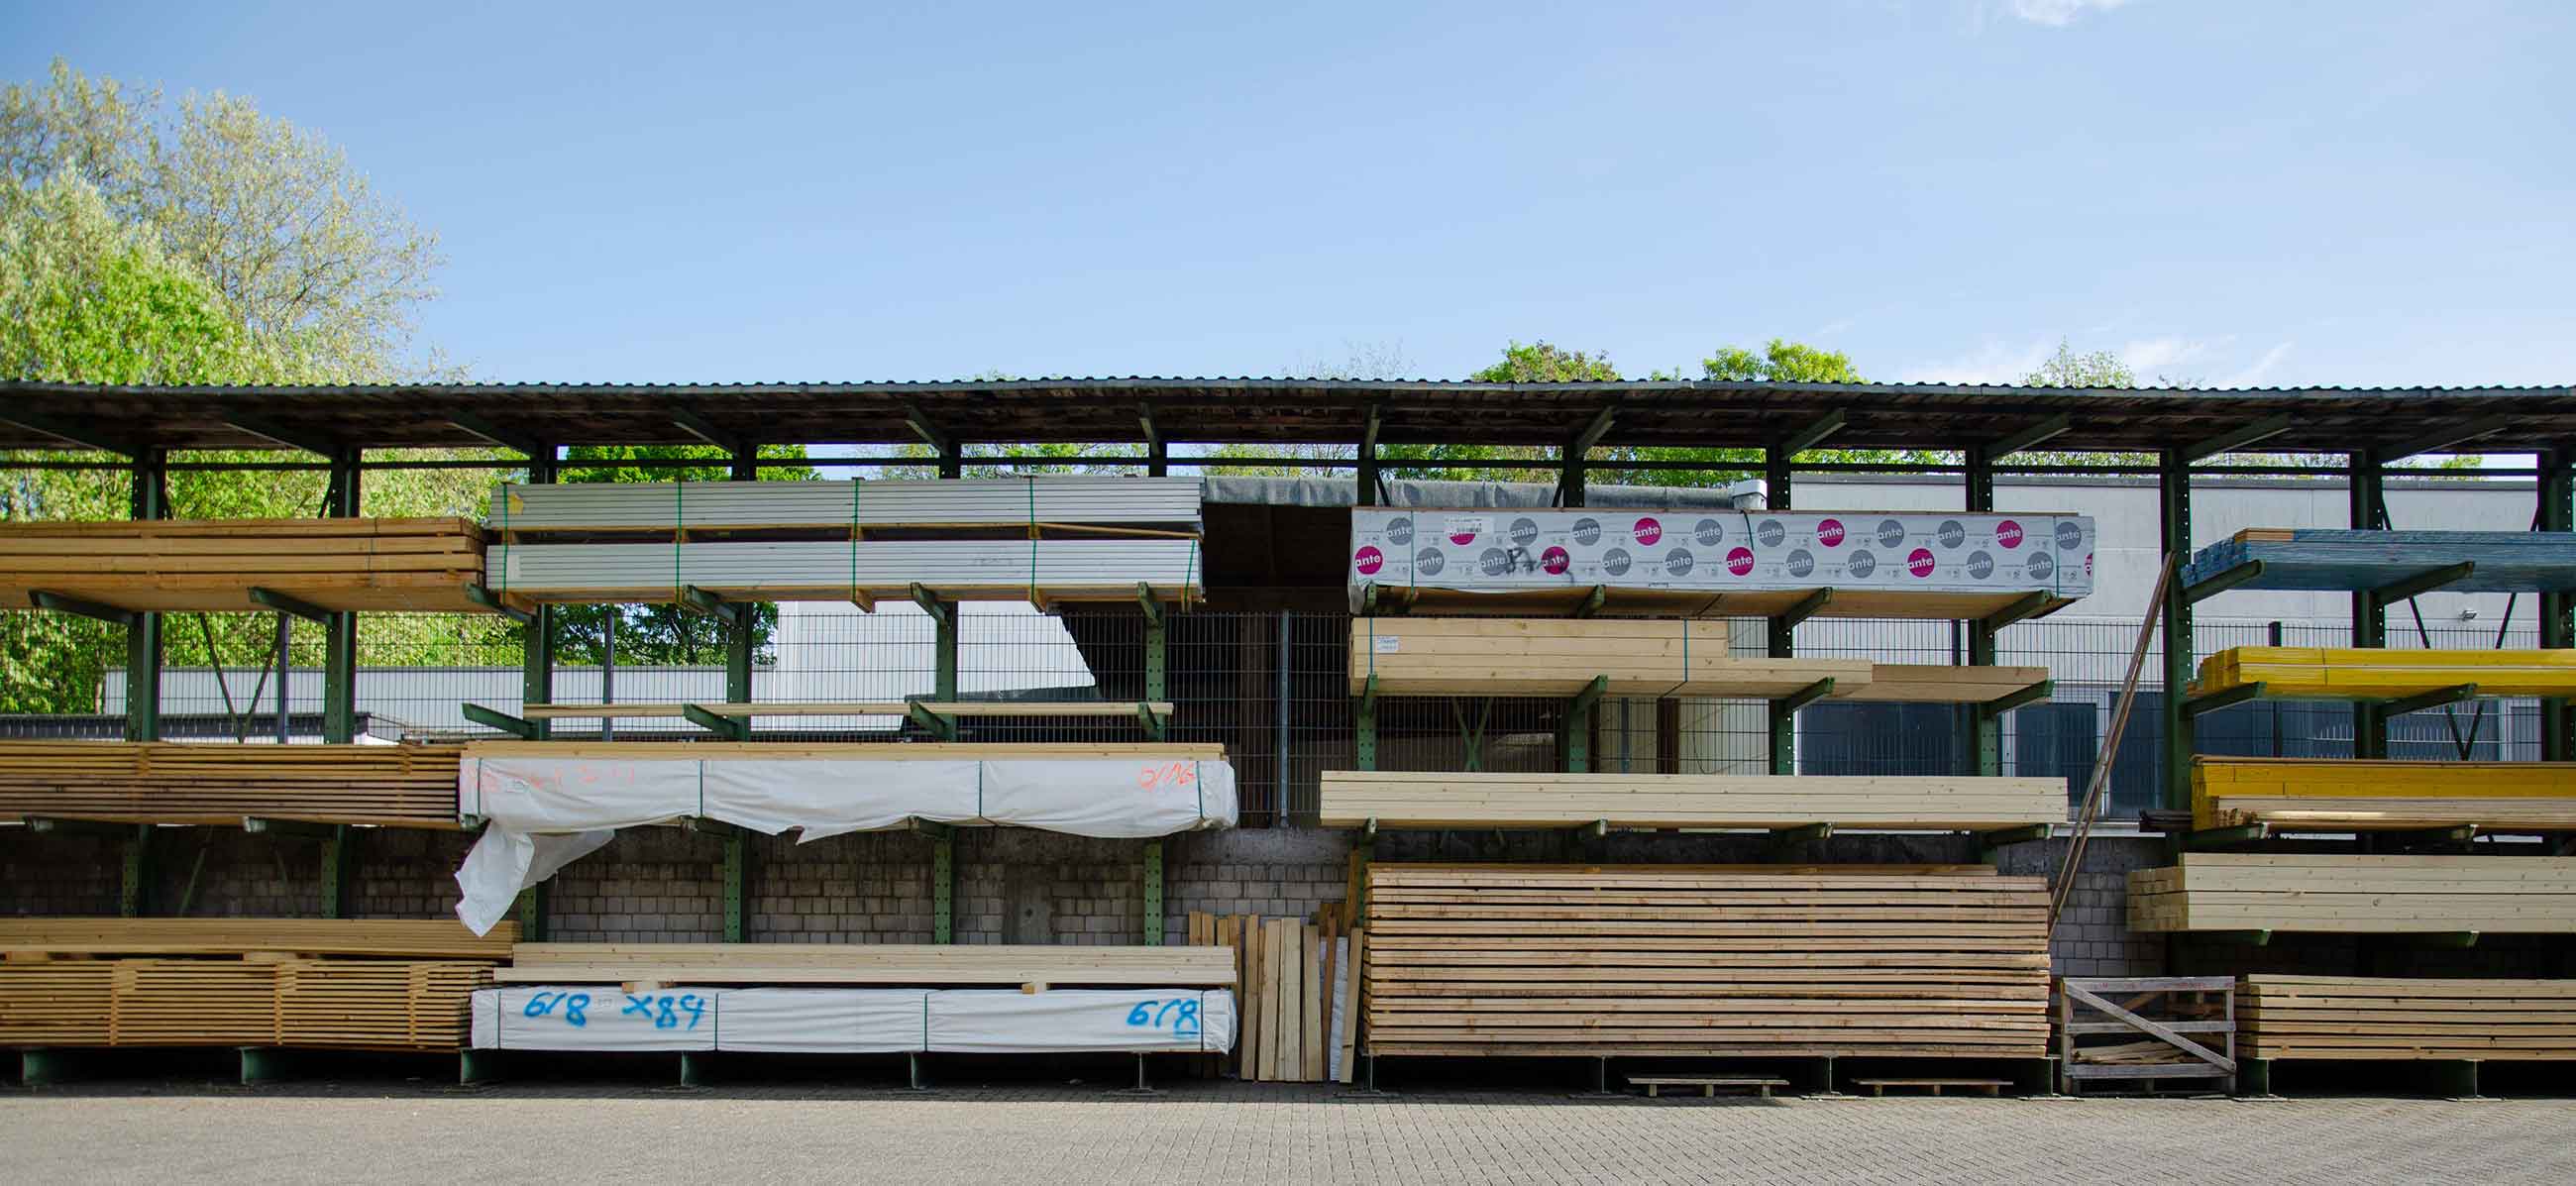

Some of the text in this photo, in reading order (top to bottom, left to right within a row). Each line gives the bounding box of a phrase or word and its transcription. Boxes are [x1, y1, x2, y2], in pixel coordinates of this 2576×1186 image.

[1510, 527, 1536, 538] ante
[1573, 527, 1598, 538] ante
[1634, 526, 1660, 538] ante
[1695, 527, 1720, 538] ante
[1758, 528, 1783, 539] ante
[1817, 528, 1843, 539] ante
[1877, 529, 1902, 540] ante
[1937, 529, 1963, 540] ante
[1995, 529, 2021, 540] ante
[1355, 555, 1380, 567] ante
[1417, 555, 1442, 568] ante
[1480, 556, 1505, 568] ante
[1603, 556, 1628, 568] ante
[1665, 556, 1690, 568] ante
[1727, 555, 1752, 568] ante
[1786, 558, 1812, 570] ante
[1849, 558, 1874, 570] ante
[1907, 557, 1933, 569] ante
[1967, 559, 1991, 571] ante
[2026, 560, 2052, 572] ante
